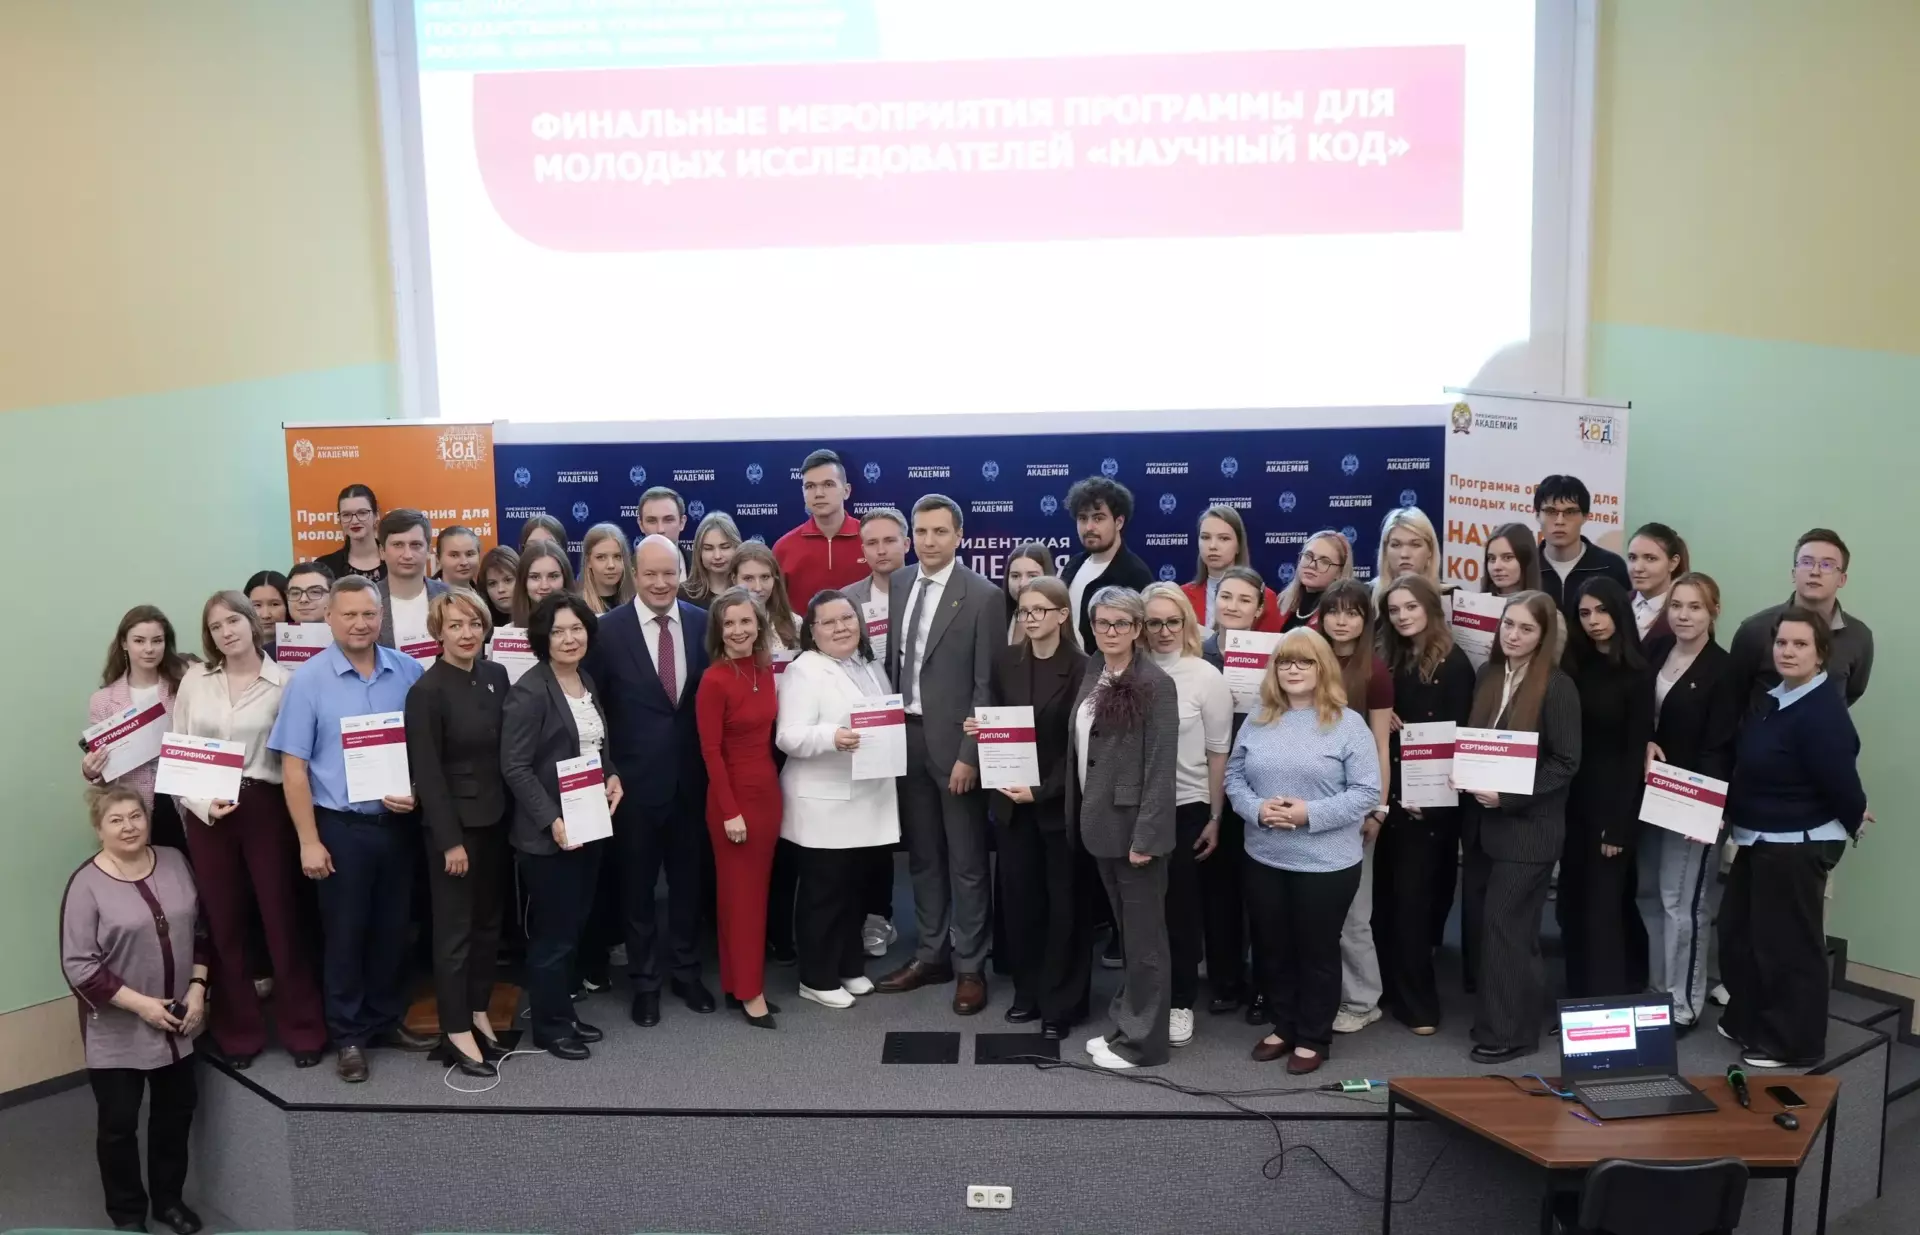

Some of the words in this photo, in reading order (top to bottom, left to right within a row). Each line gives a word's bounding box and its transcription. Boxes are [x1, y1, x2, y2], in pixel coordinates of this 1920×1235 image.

[531, 105, 767, 141] ФИНАЛЬНЫЕ
[777, 97, 1053, 135] МЕРОПРИЯТИЯ
[1063, 89, 1305, 127] ПРОГРАММЫ
[1313, 87, 1396, 124] ДЛЯ
[533, 148, 727, 186] МОЛОДЫХ
[736, 131, 1075, 181] ИССЛЕДОВАТЕЛЕЙ
[1086, 126, 1296, 168] «НАУЧНЫЙ
[1308, 131, 1411, 167] КОД»
[1475, 419, 1518, 430] АКАДЕМИЯ
[317, 450, 360, 459] АКАДЕМИЯ
[1146, 466, 1188, 474] АКАДЕМИЯ
[1266, 465, 1309, 473] АКАДЕМИЯ
[1387, 462, 1430, 470] АКАДЕМИЯ
[908, 470, 950, 478] АКАДЕМИЯ
[1027, 468, 1069, 476] АКАДЕМИЯ
[557, 475, 599, 483] АКАДЕМИЯ
[674, 474, 715, 482] АКАДЕМИЯ
[1450, 474, 1520, 493] Программа
[1593, 492, 1618, 505] для
[1329, 499, 1372, 507] АКАДЕМИЯ
[1449, 494, 1505, 511] молодых
[736, 508, 778, 516] АКАДЕМИЯ
[971, 504, 1013, 512] АКАДЕМИЯ
[297, 509, 340, 525] Прогр
[462, 507, 489, 520] для
[297, 529, 345, 542] молод
[1146, 537, 1188, 545] АКАДЕМИЯ
[1447, 555, 1479, 583] КО
[1453, 615, 1481, 626] ДИПЛОМ
[869, 623, 888, 633] ДИПЛ
[498, 641, 532, 649] СЕРТИФ
[279, 650, 311, 658] ДИПЛОМ
[1226, 656, 1259, 664] ДИПЛОМ
[94, 719, 140, 748] СЕРТИФИКАТ
[979, 732, 1010, 740] ДИПЛОМ
[1459, 742, 1509, 753] СЕРТИФИКАТ
[165, 747, 216, 762] СЕРТИФИКАТ
[1402, 748, 1433, 757] ДИПЛОМ
[1652, 777, 1699, 796] СЕРТИФИКАТ
